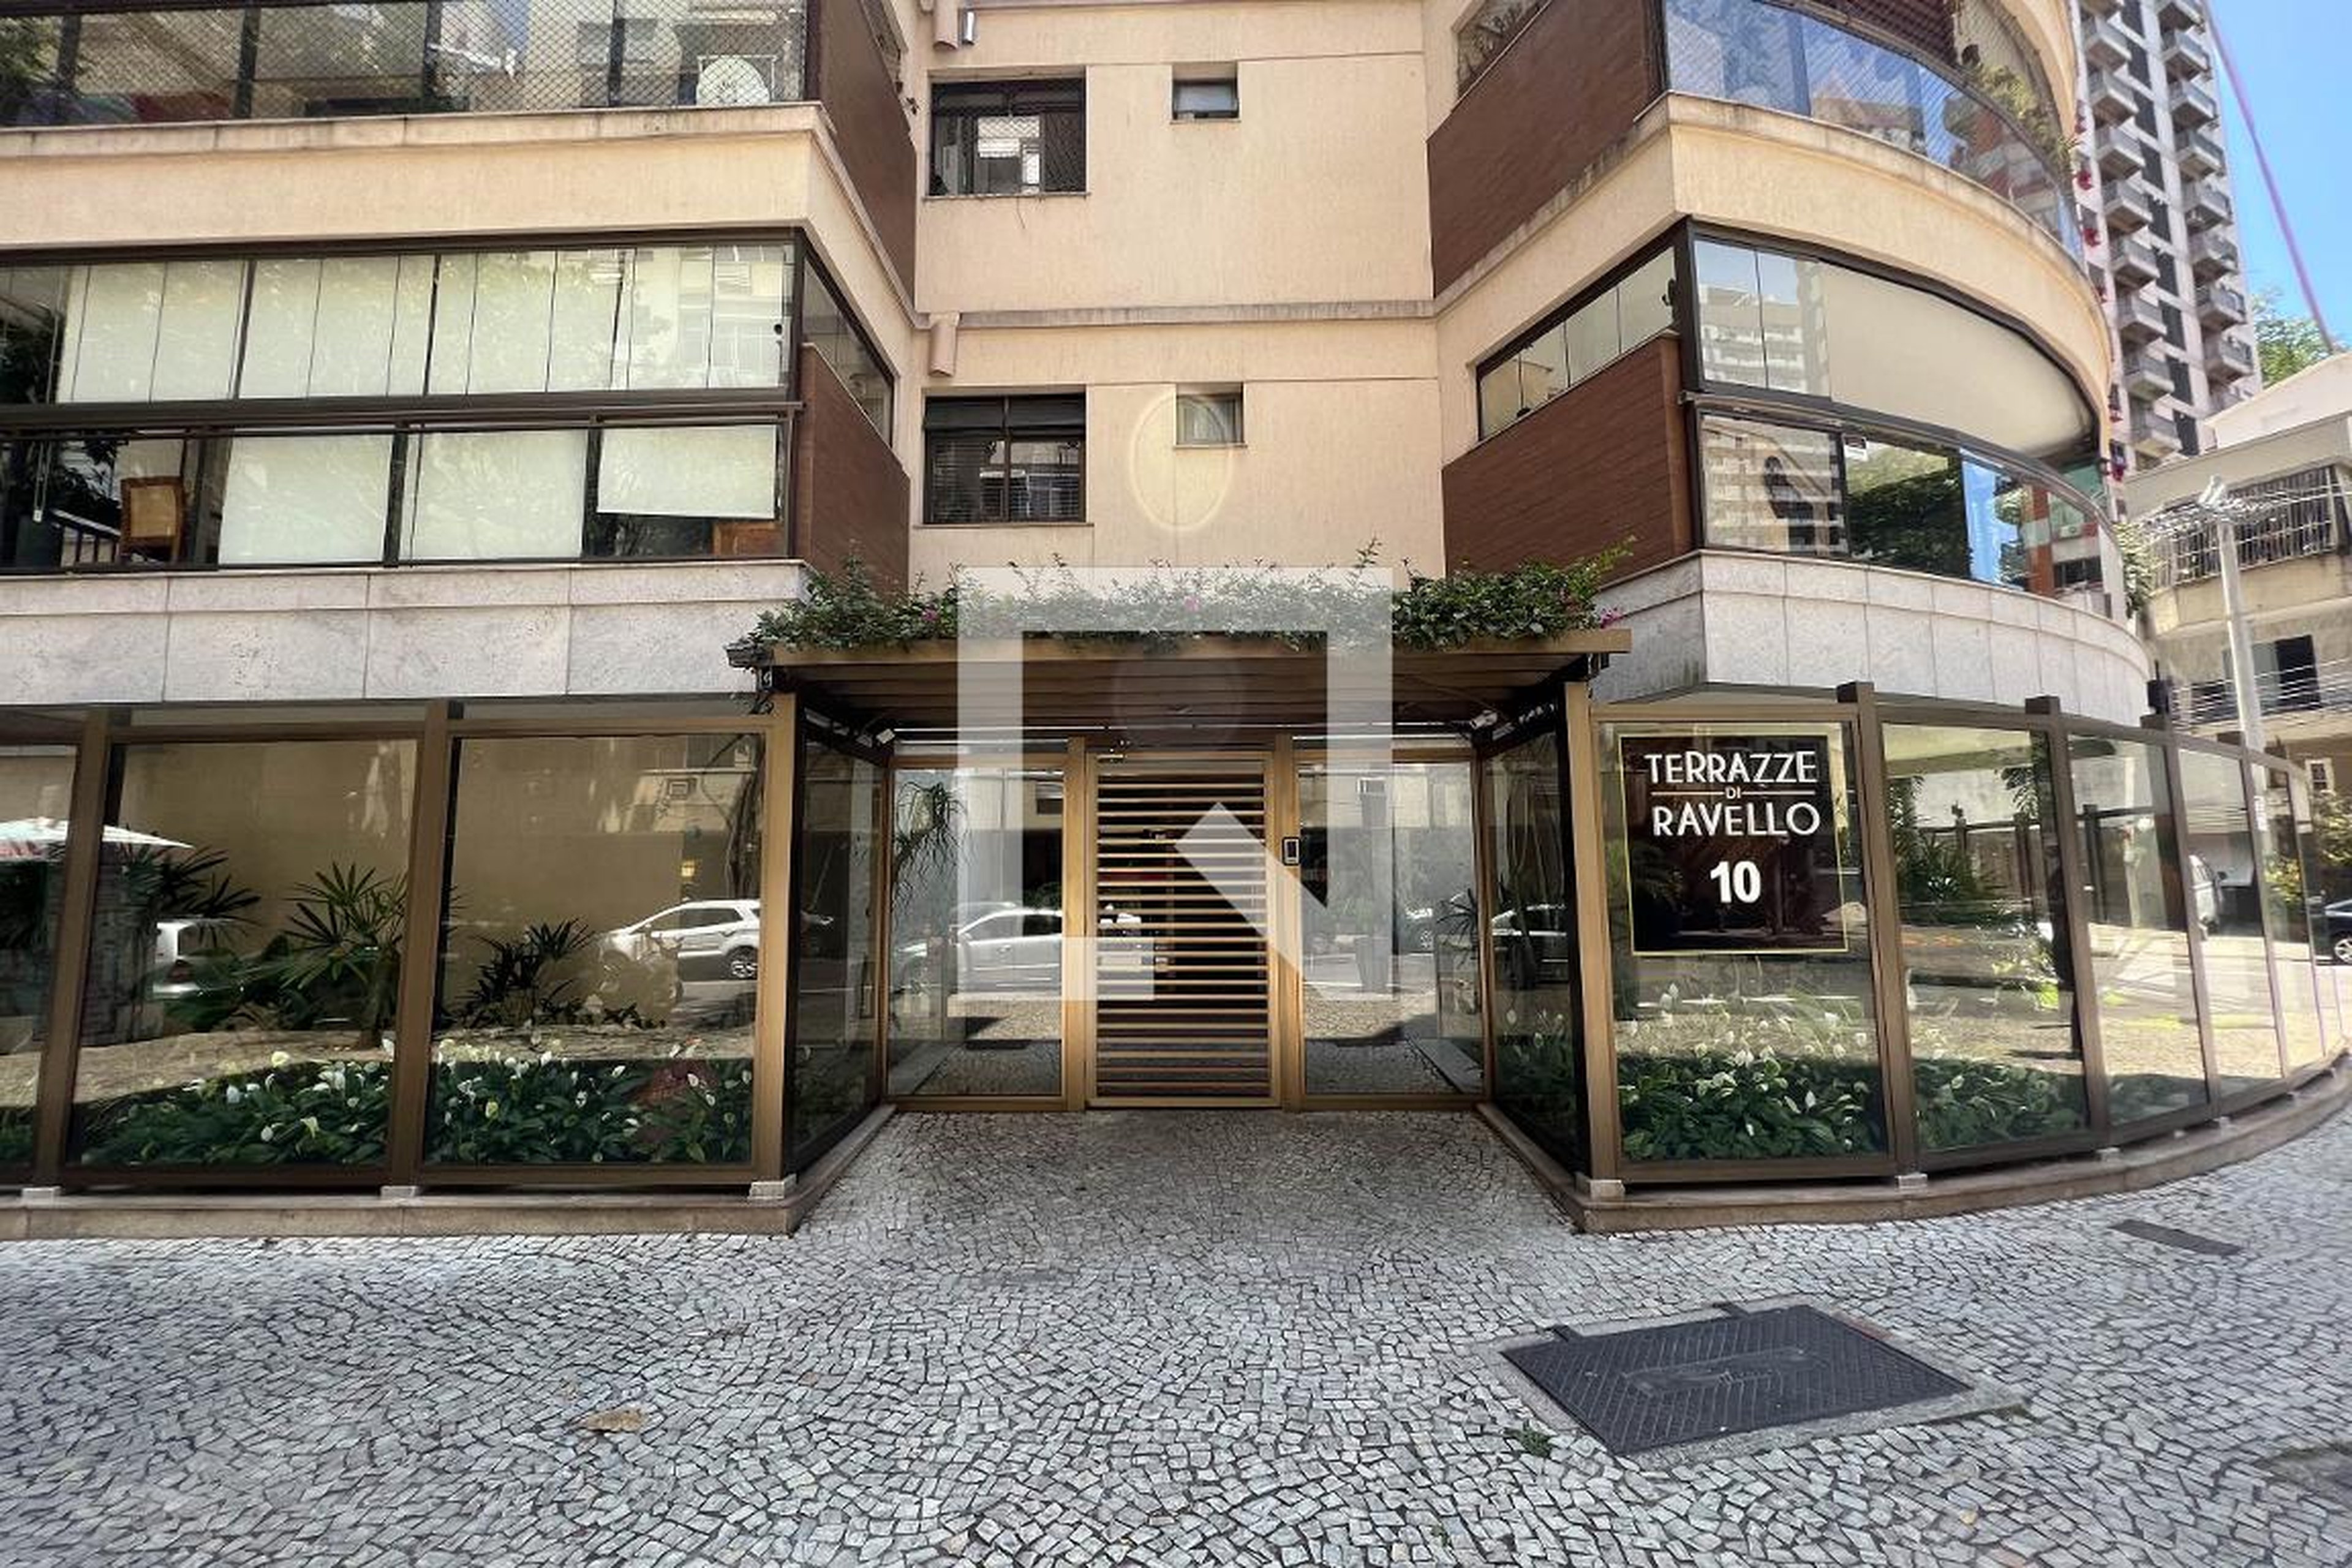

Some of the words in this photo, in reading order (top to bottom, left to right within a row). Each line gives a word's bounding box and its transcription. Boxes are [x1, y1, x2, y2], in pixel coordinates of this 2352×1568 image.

[1644, 751, 1818, 783] TERRAZZE
[1725, 786, 1741, 799] DI
[1653, 802, 1820, 836] RAVELLO
[1710, 861, 1761, 903] 10
